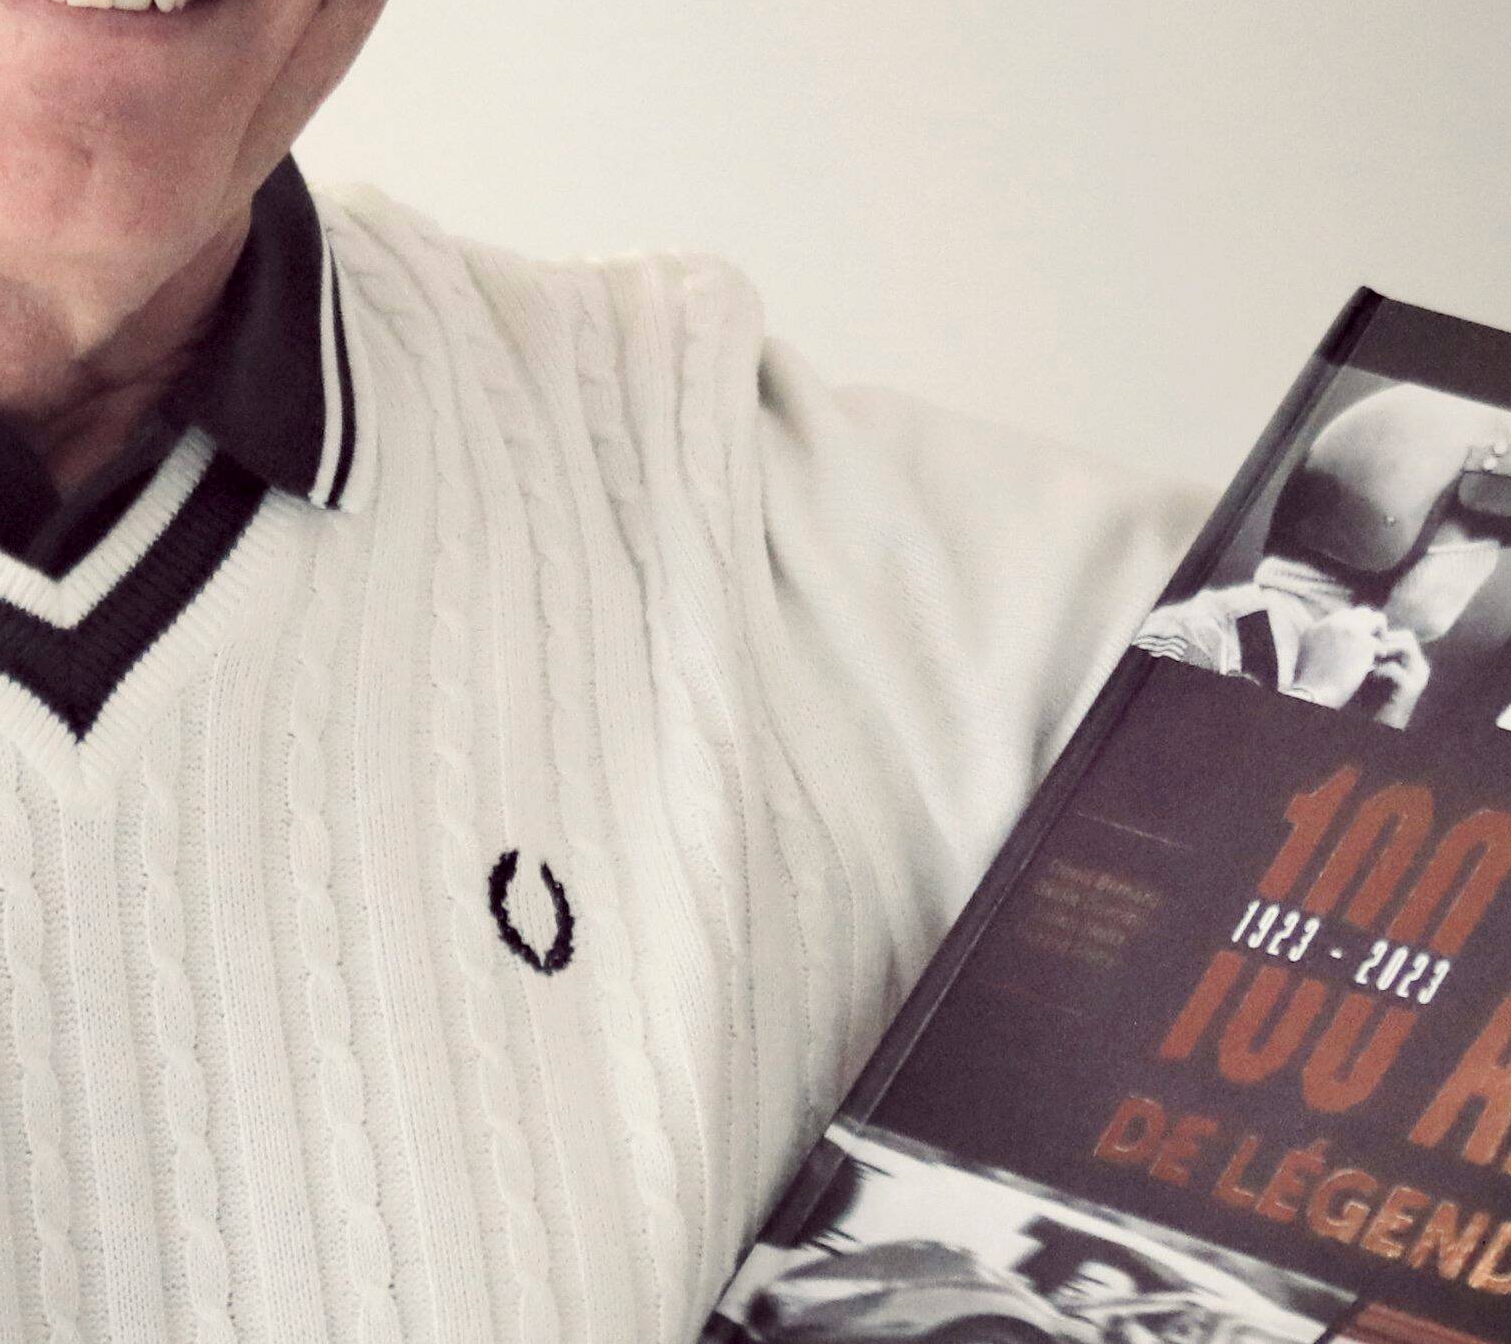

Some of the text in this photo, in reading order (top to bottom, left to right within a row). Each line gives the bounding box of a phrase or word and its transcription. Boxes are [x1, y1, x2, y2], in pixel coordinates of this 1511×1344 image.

[1231, 899, 1322, 963] 1923
[1354, 938, 1452, 1005] 2023
[1092, 1096, 1220, 1188] DE
